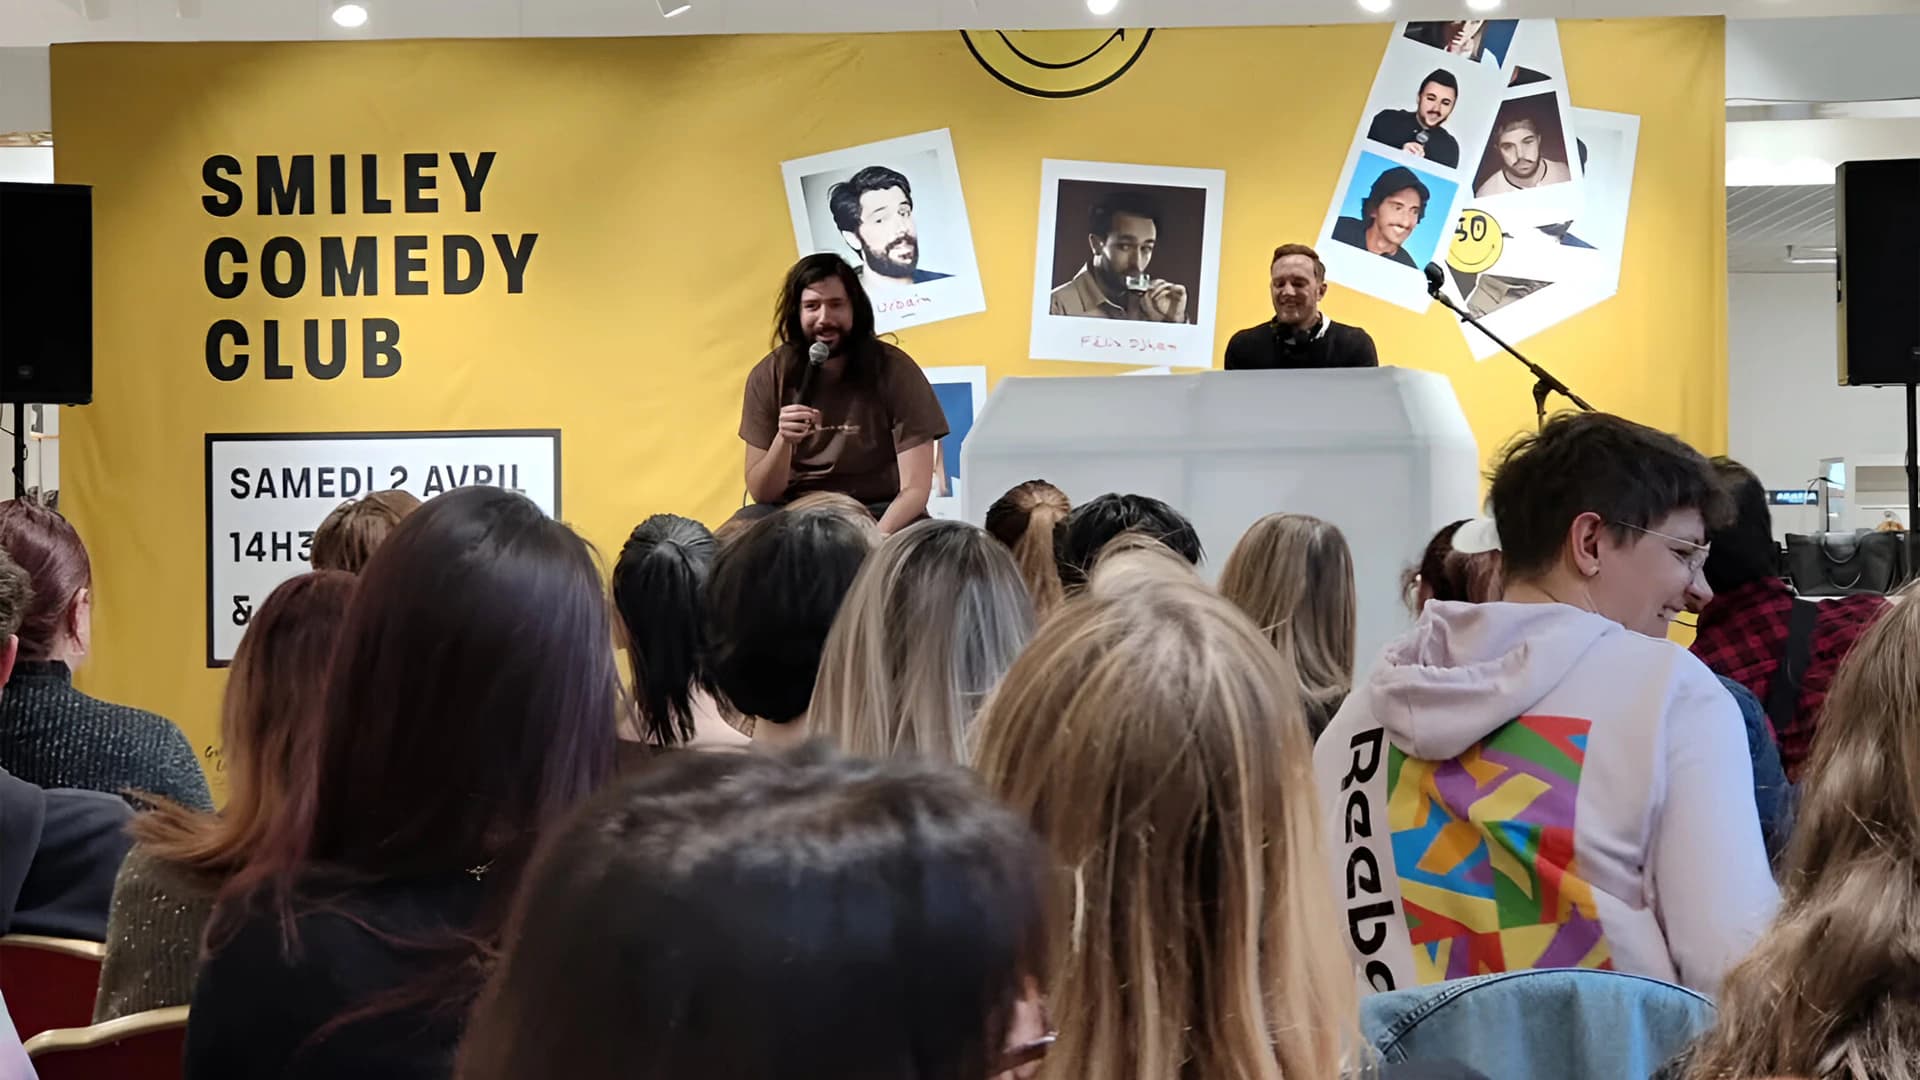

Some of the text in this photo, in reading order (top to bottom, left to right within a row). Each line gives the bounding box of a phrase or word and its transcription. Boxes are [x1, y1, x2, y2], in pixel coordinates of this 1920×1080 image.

[201, 151, 497, 217] SMILEY
[204, 233, 539, 299] COMEDY
[205, 318, 402, 381] CLUB
[230, 464, 526, 499] SAMEDI 2 AVRIL
[232, 595, 252, 626] &
